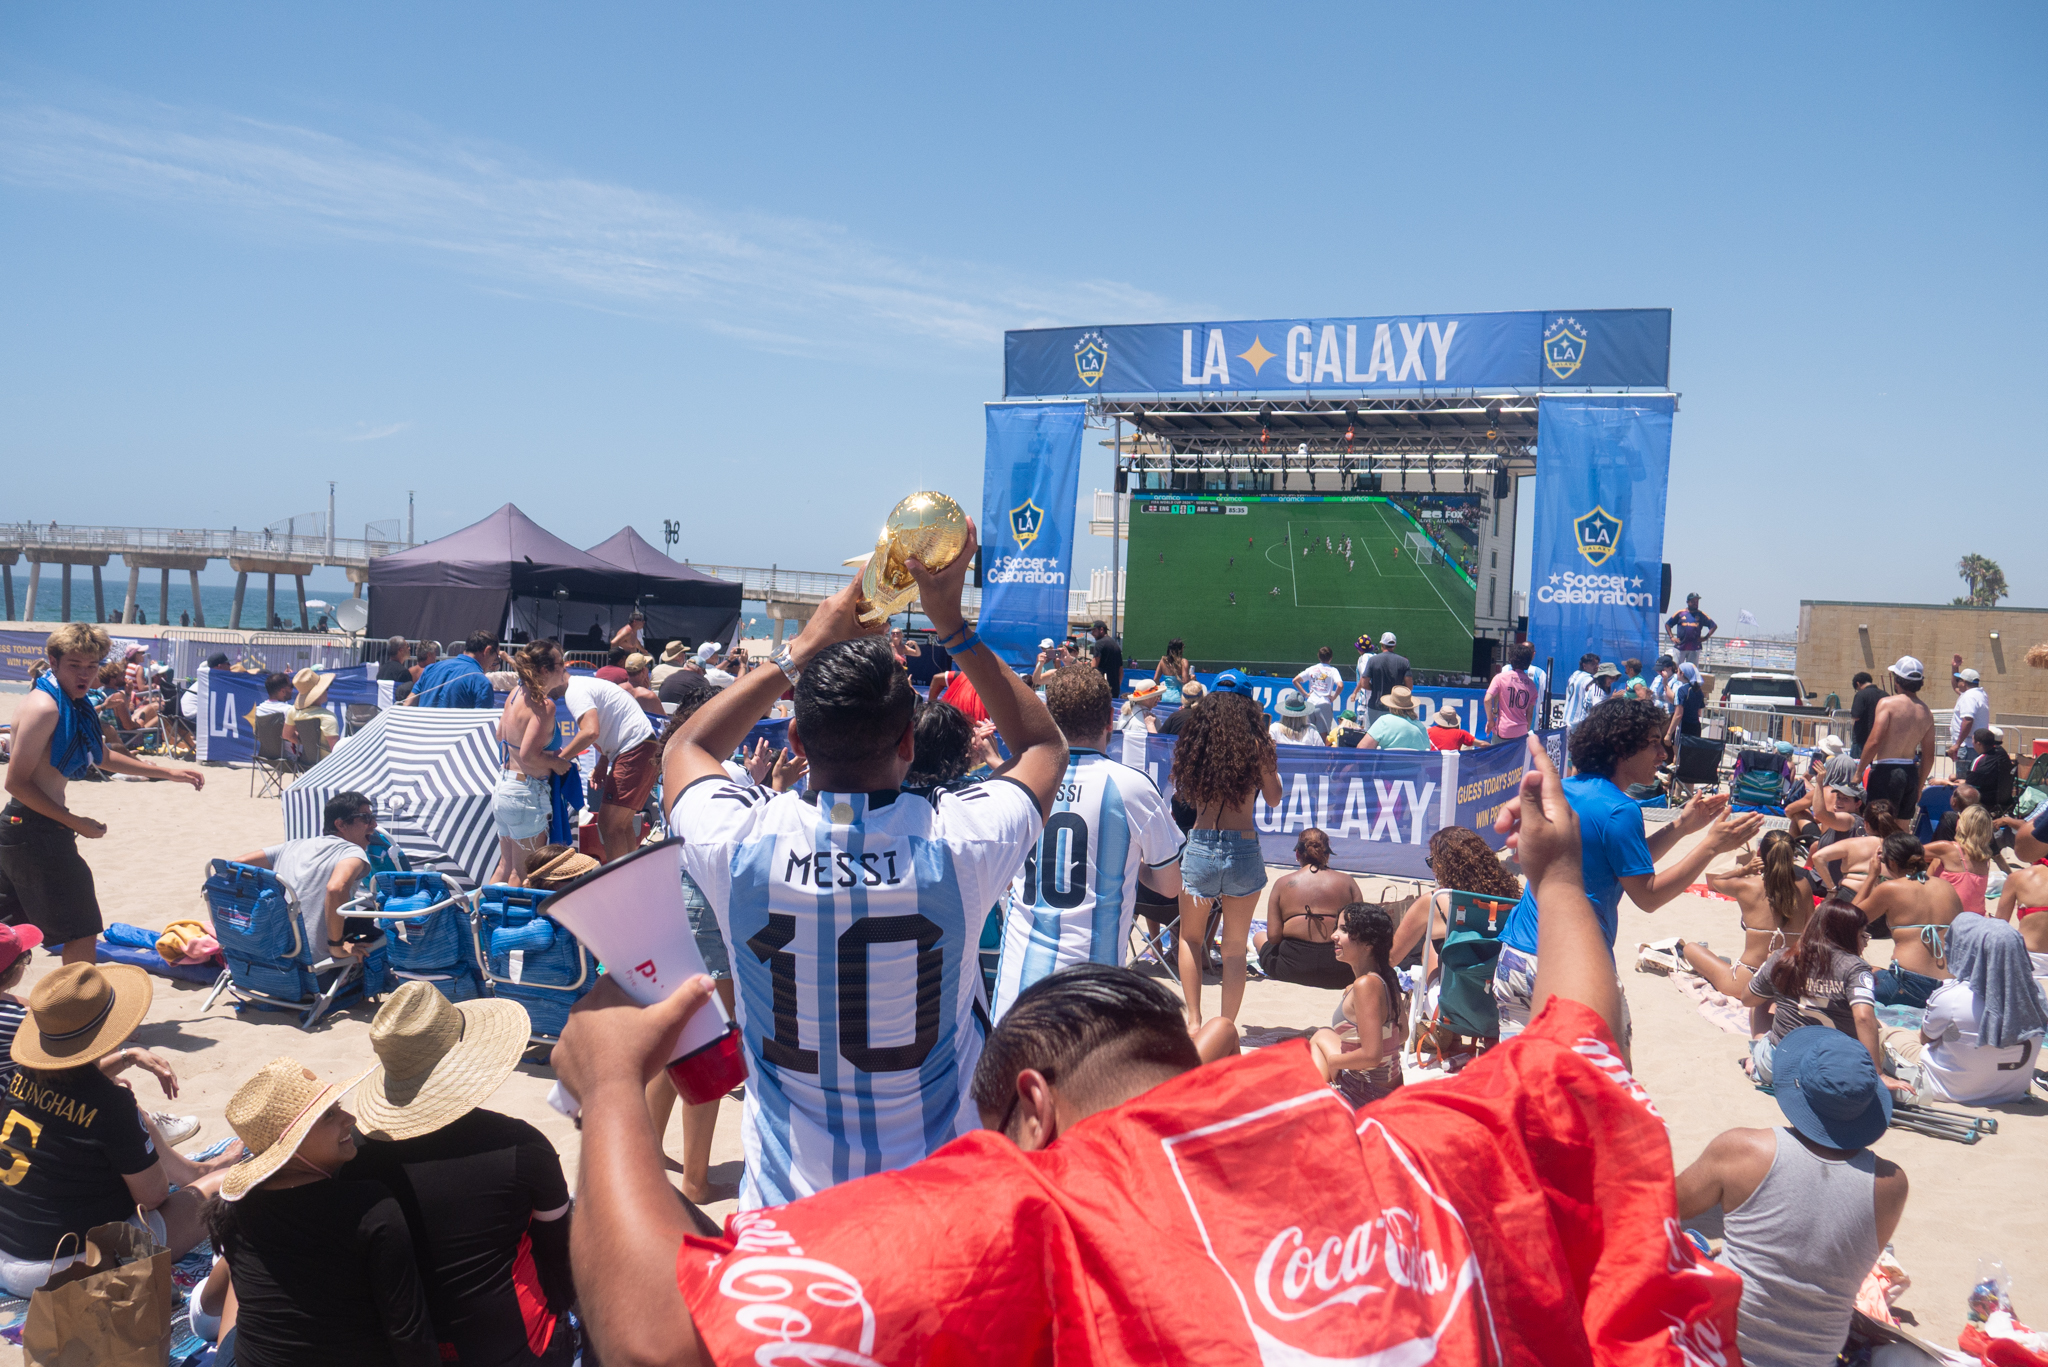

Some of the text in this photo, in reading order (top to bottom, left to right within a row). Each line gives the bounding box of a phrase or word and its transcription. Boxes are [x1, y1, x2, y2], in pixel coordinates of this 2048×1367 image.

[1182, 321, 1459, 385] LA GALAXY
[1553, 347, 1576, 360] LA
[1082, 358, 1100, 370] LA
[1018, 517, 1034, 531] LA
[1445, 511, 1464, 519] FOX
[1584, 527, 1611, 544] LA
[1003, 555, 1047, 570] Soccer
[1562, 571, 1629, 589] Soccer
[1537, 585, 1653, 607] Celebration
[12, 645, 43, 655] TODAY'S
[6, 658, 22, 666] WIN
[1507, 686, 1530, 709] 10
[209, 691, 239, 739] LA
[1457, 780, 1482, 805] GUESS
[1483, 772, 1508, 797] TODAY'S
[1254, 773, 1437, 845] GALAXY
[1475, 810, 1490, 829] WIN
[784, 848, 901, 888] MESSI
[745, 912, 944, 1075] 10
[1806, 977, 1846, 995] INGHAM
[9, 1072, 99, 1128] ELLINGHAM
